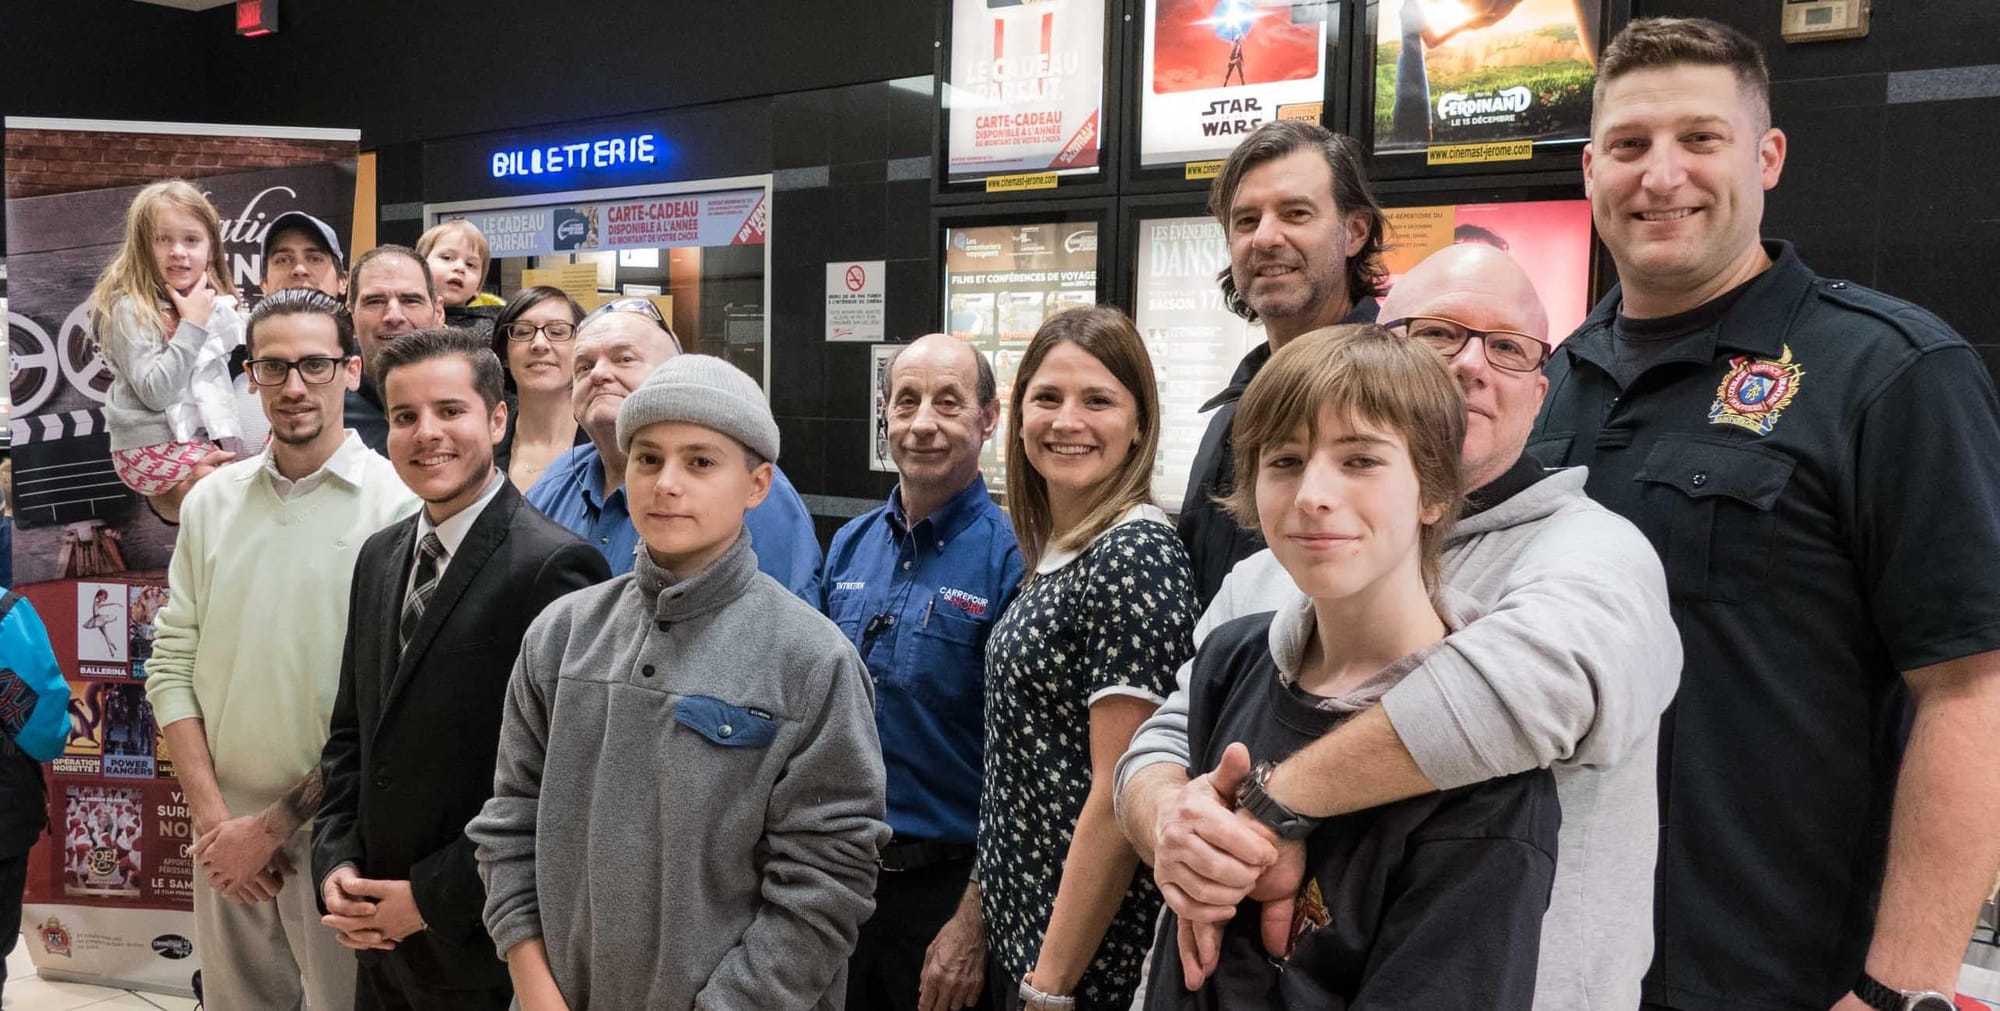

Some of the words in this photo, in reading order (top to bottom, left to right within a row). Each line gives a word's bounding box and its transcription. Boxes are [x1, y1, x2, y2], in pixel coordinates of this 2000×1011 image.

[992, 52, 1079, 82] CADEAU
[1202, 97, 1262, 116] STAR
[1437, 86, 1531, 120] FERDINAND
[975, 111, 1063, 129] CARTE-CADEAU
[1202, 118, 1262, 137] WARS
[1472, 114, 1516, 125] DÉCEMBRE
[975, 127, 1019, 139] DISPONIBLE
[1028, 125, 1062, 136] L'ANNÉE
[492, 134, 655, 178] BILLETTERIE
[1430, 144, 1531, 161] www.cinemast-jerome.com
[607, 200, 699, 223] CARTE-CADEAU
[483, 216, 497, 235] LE
[497, 213, 545, 233] CADEAU
[608, 222, 654, 235] DISPONIBLE
[663, 218, 698, 232] L'ANNÉE
[608, 236, 616, 245] AU
[617, 234, 647, 244] MONTANT
[648, 233, 657, 242] DE
[658, 232, 676, 242] VOTRE
[678, 231, 698, 241] CHOIX
[952, 275, 975, 285] FILMS
[976, 274, 986, 283] ET
[987, 271, 1046, 283] CONFÉRENCES
[1047, 272, 1059, 281] DE
[939, 586, 989, 608] CARREFOUR
[951, 597, 985, 615] NORD
[80, 666, 127, 676] BALLERINA
[53, 757, 100, 767] OPÉRATION
[53, 764, 94, 773] NOISETTE
[106, 766, 153, 775] RANGERS
[111, 759, 149, 768] POWER
[151, 878, 165, 888] LE
[169, 879, 193, 890] SAM
